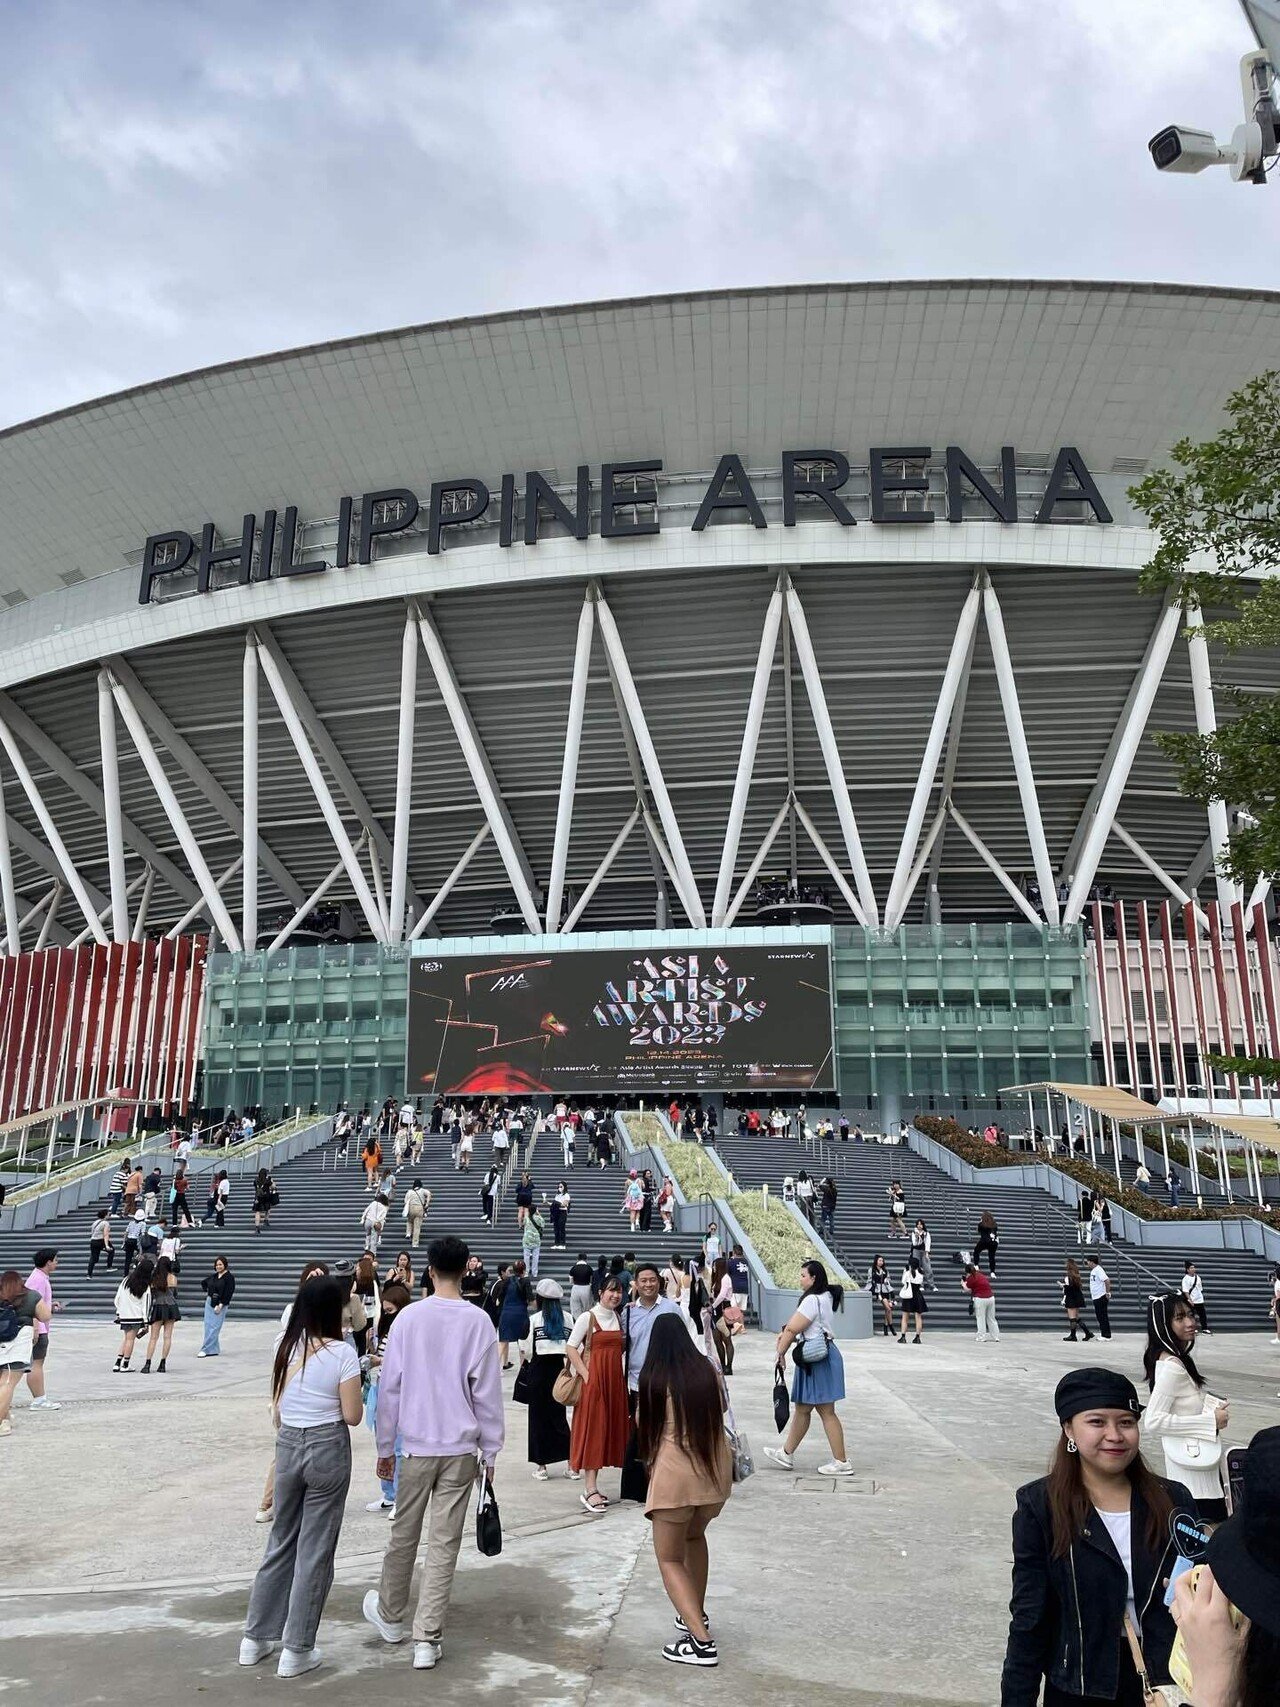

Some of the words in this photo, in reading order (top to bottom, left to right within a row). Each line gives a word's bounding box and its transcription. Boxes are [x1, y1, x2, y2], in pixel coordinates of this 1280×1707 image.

[140, 459, 662, 603] PHILIPPINE
[691, 446, 1114, 531] ARENA
[627, 955, 730, 980] ASIA
[599, 977, 755, 1002] ARTIST
[586, 1001, 767, 1026] AWARDS
[629, 1025, 726, 1045] 2023
[1074, 1113, 1083, 1126] 2
